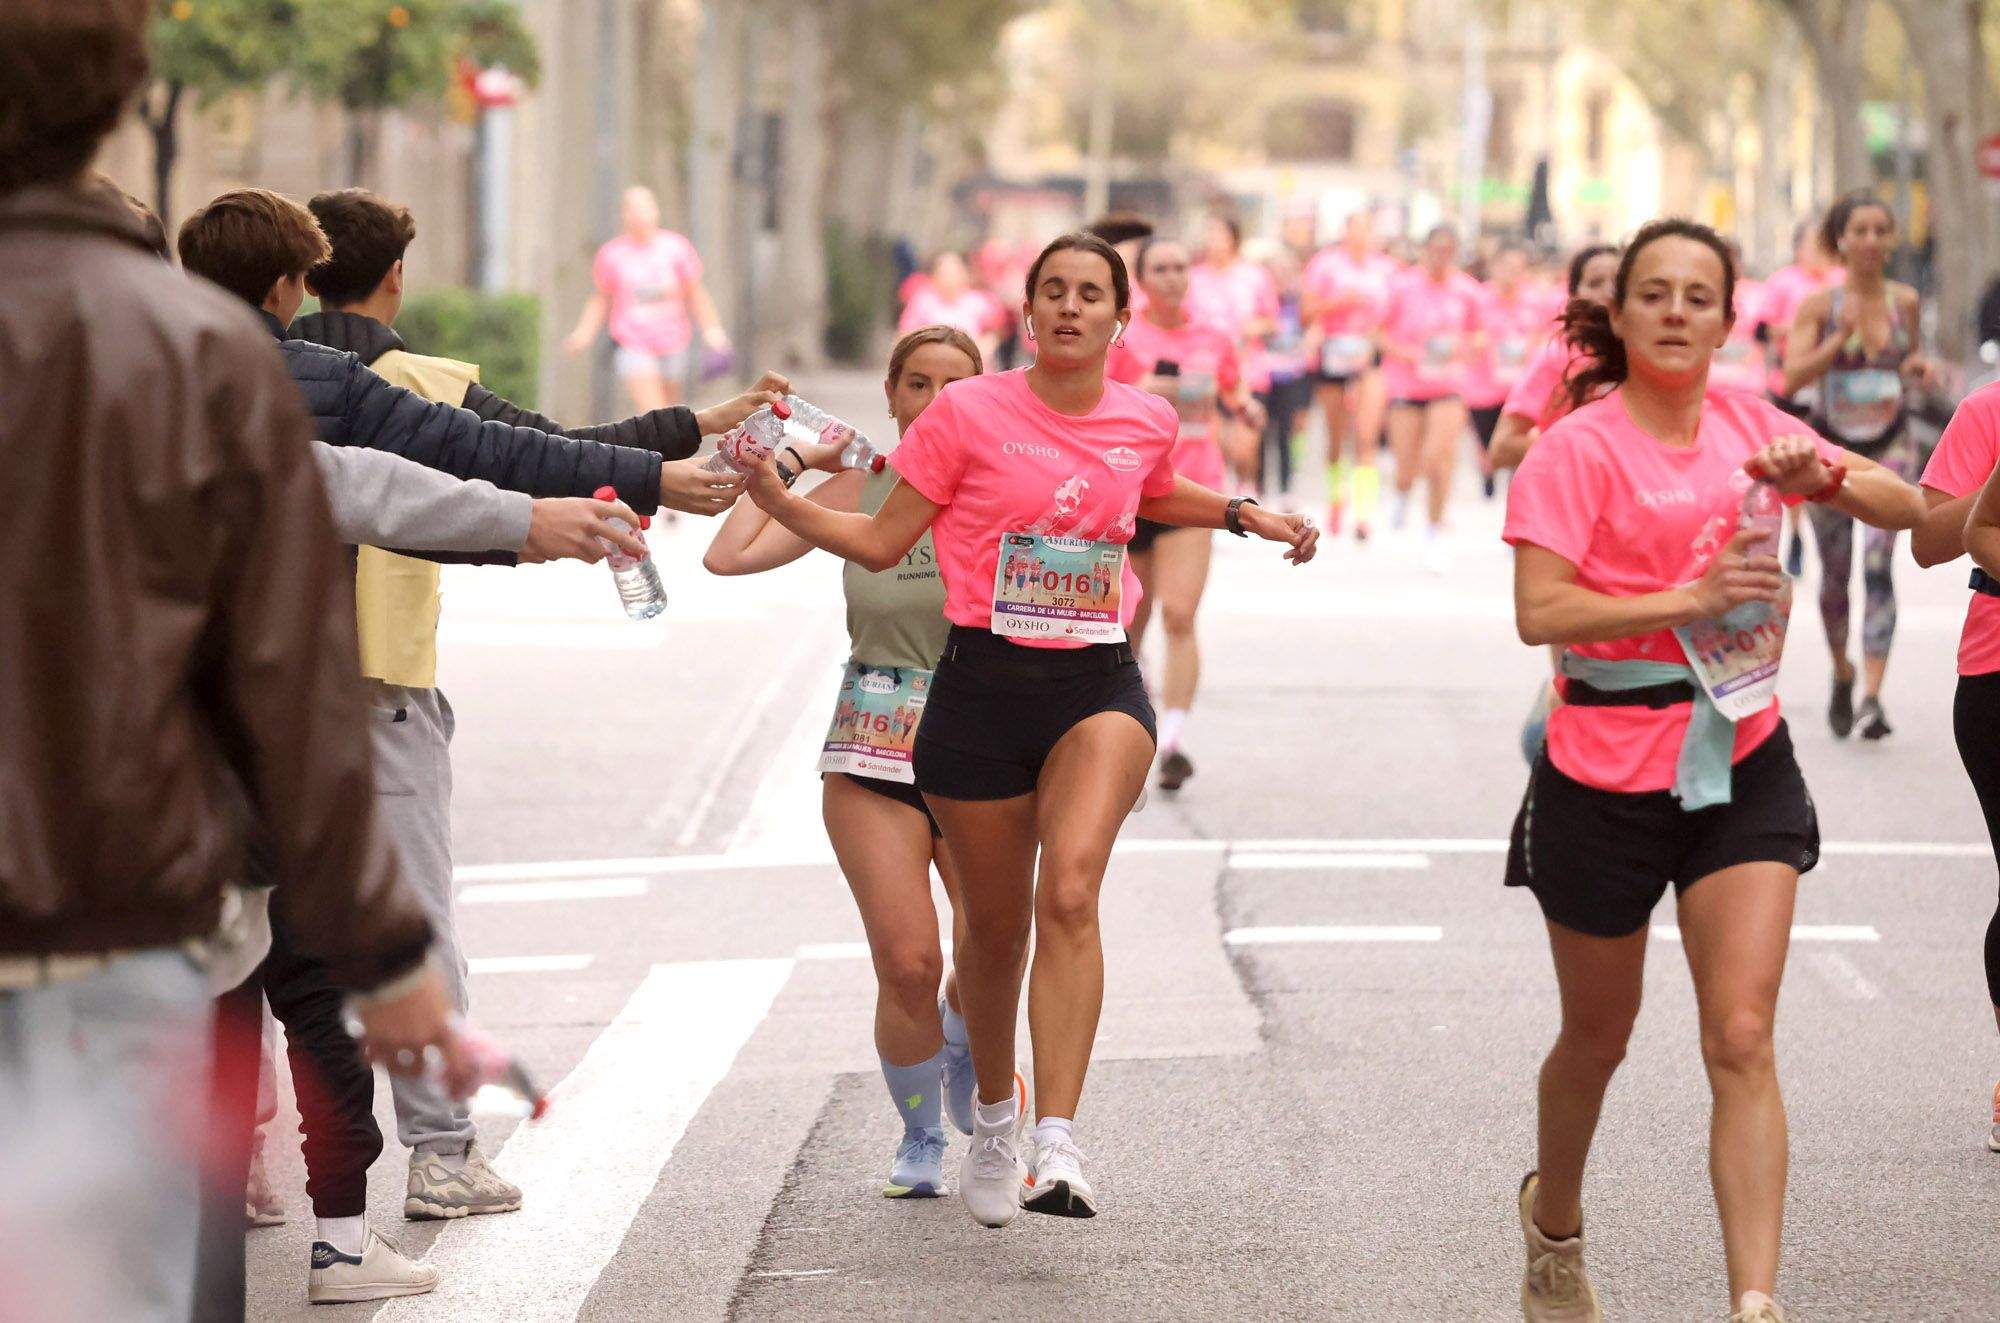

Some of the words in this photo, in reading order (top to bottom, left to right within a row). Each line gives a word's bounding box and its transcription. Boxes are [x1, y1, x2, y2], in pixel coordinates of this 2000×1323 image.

[1002, 441, 1060, 459] OYSHO
[897, 570, 936, 581] RUNNING
[1042, 571, 1090, 593] 016
[1052, 597, 1075, 607] 3072
[1007, 603, 1036, 613] CARRERA
[1056, 608, 1076, 617] MUJER
[1080, 611, 1109, 620] BARCELONA
[1007, 618, 1050, 632] OYSHO
[1074, 626, 1109, 636] Santander
[850, 711, 889, 732] 016
[851, 743, 872, 754] MUJER
[875, 748, 907, 759] BARCELONA
[867, 762, 902, 774] Santander
